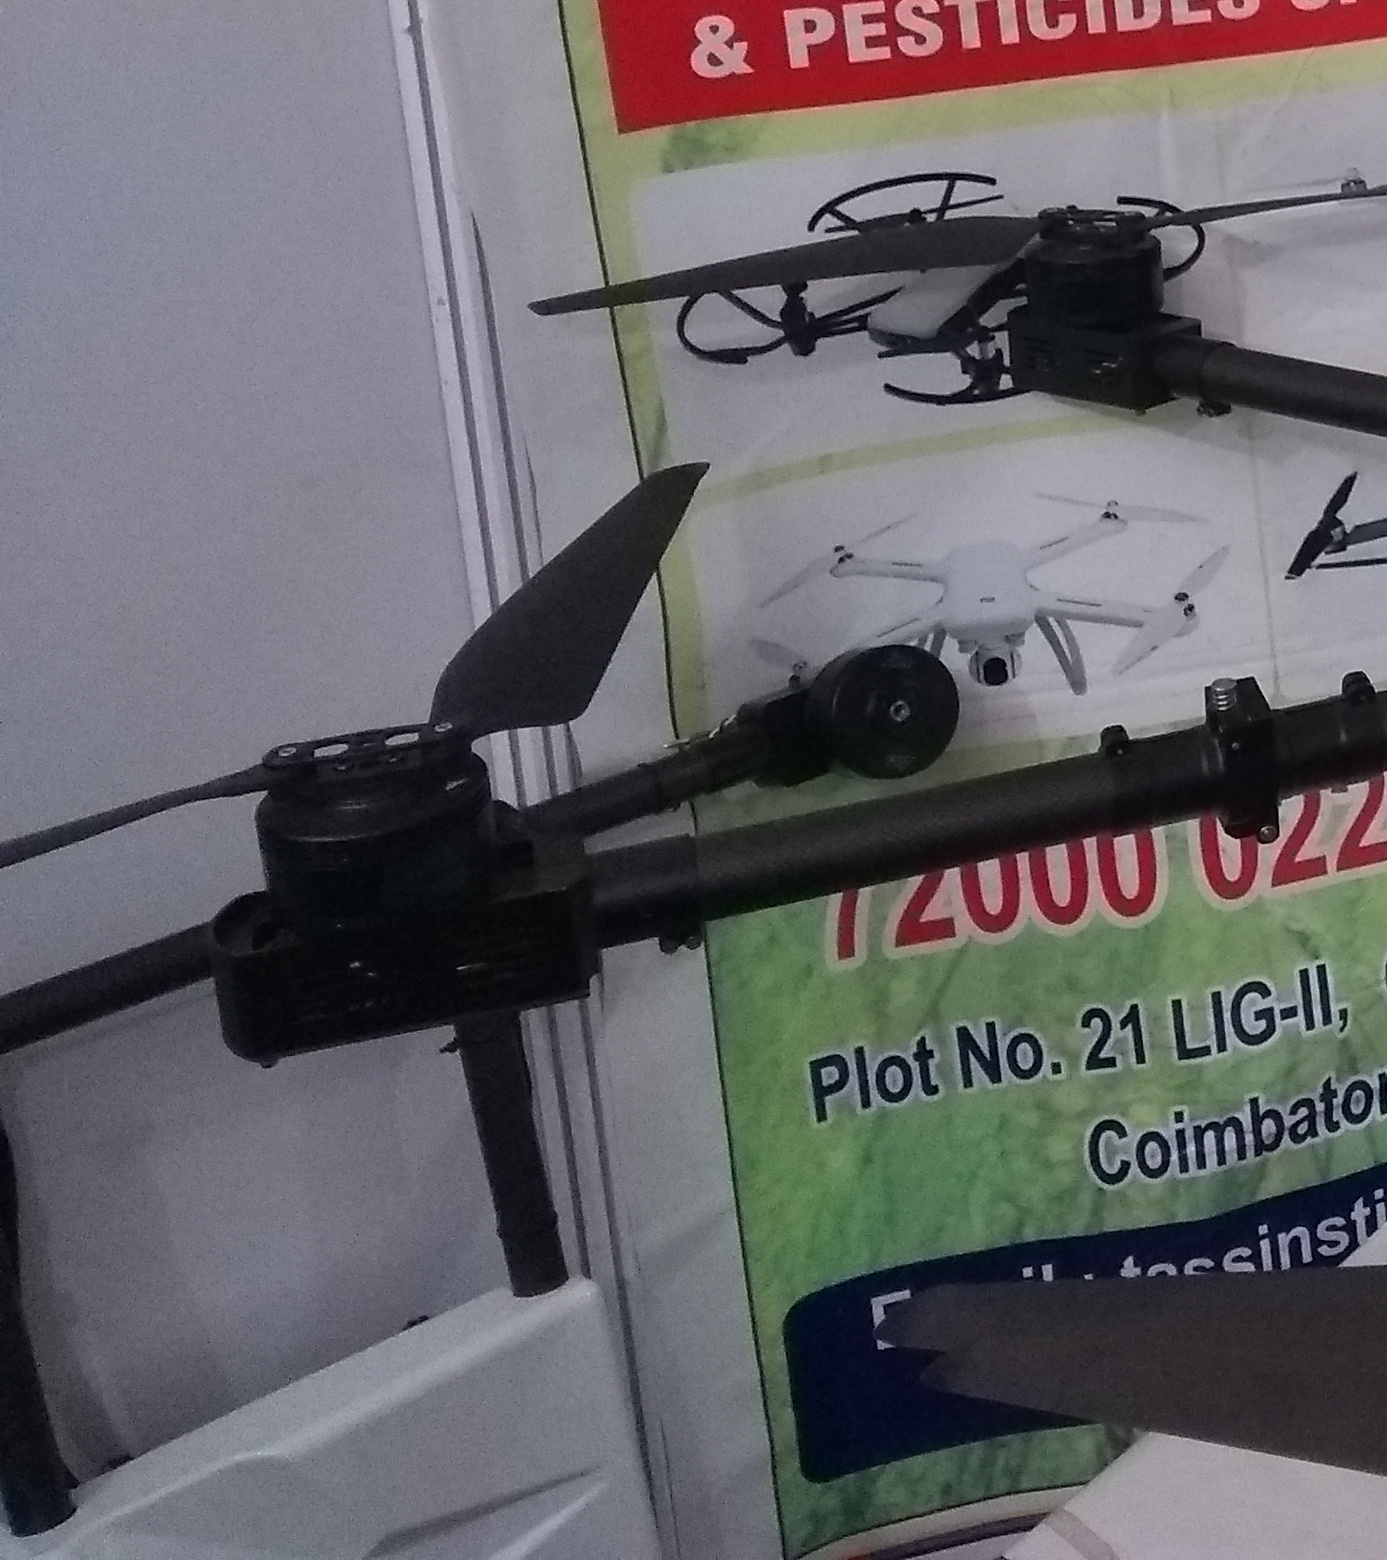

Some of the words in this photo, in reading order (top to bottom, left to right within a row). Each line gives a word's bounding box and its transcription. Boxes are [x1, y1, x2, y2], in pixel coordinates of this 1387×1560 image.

[690, 14, 755, 79] &
[808, 1036, 940, 1124] Plot
[955, 1020, 1062, 1090] No.
[1081, 1003, 1147, 1071] 21
